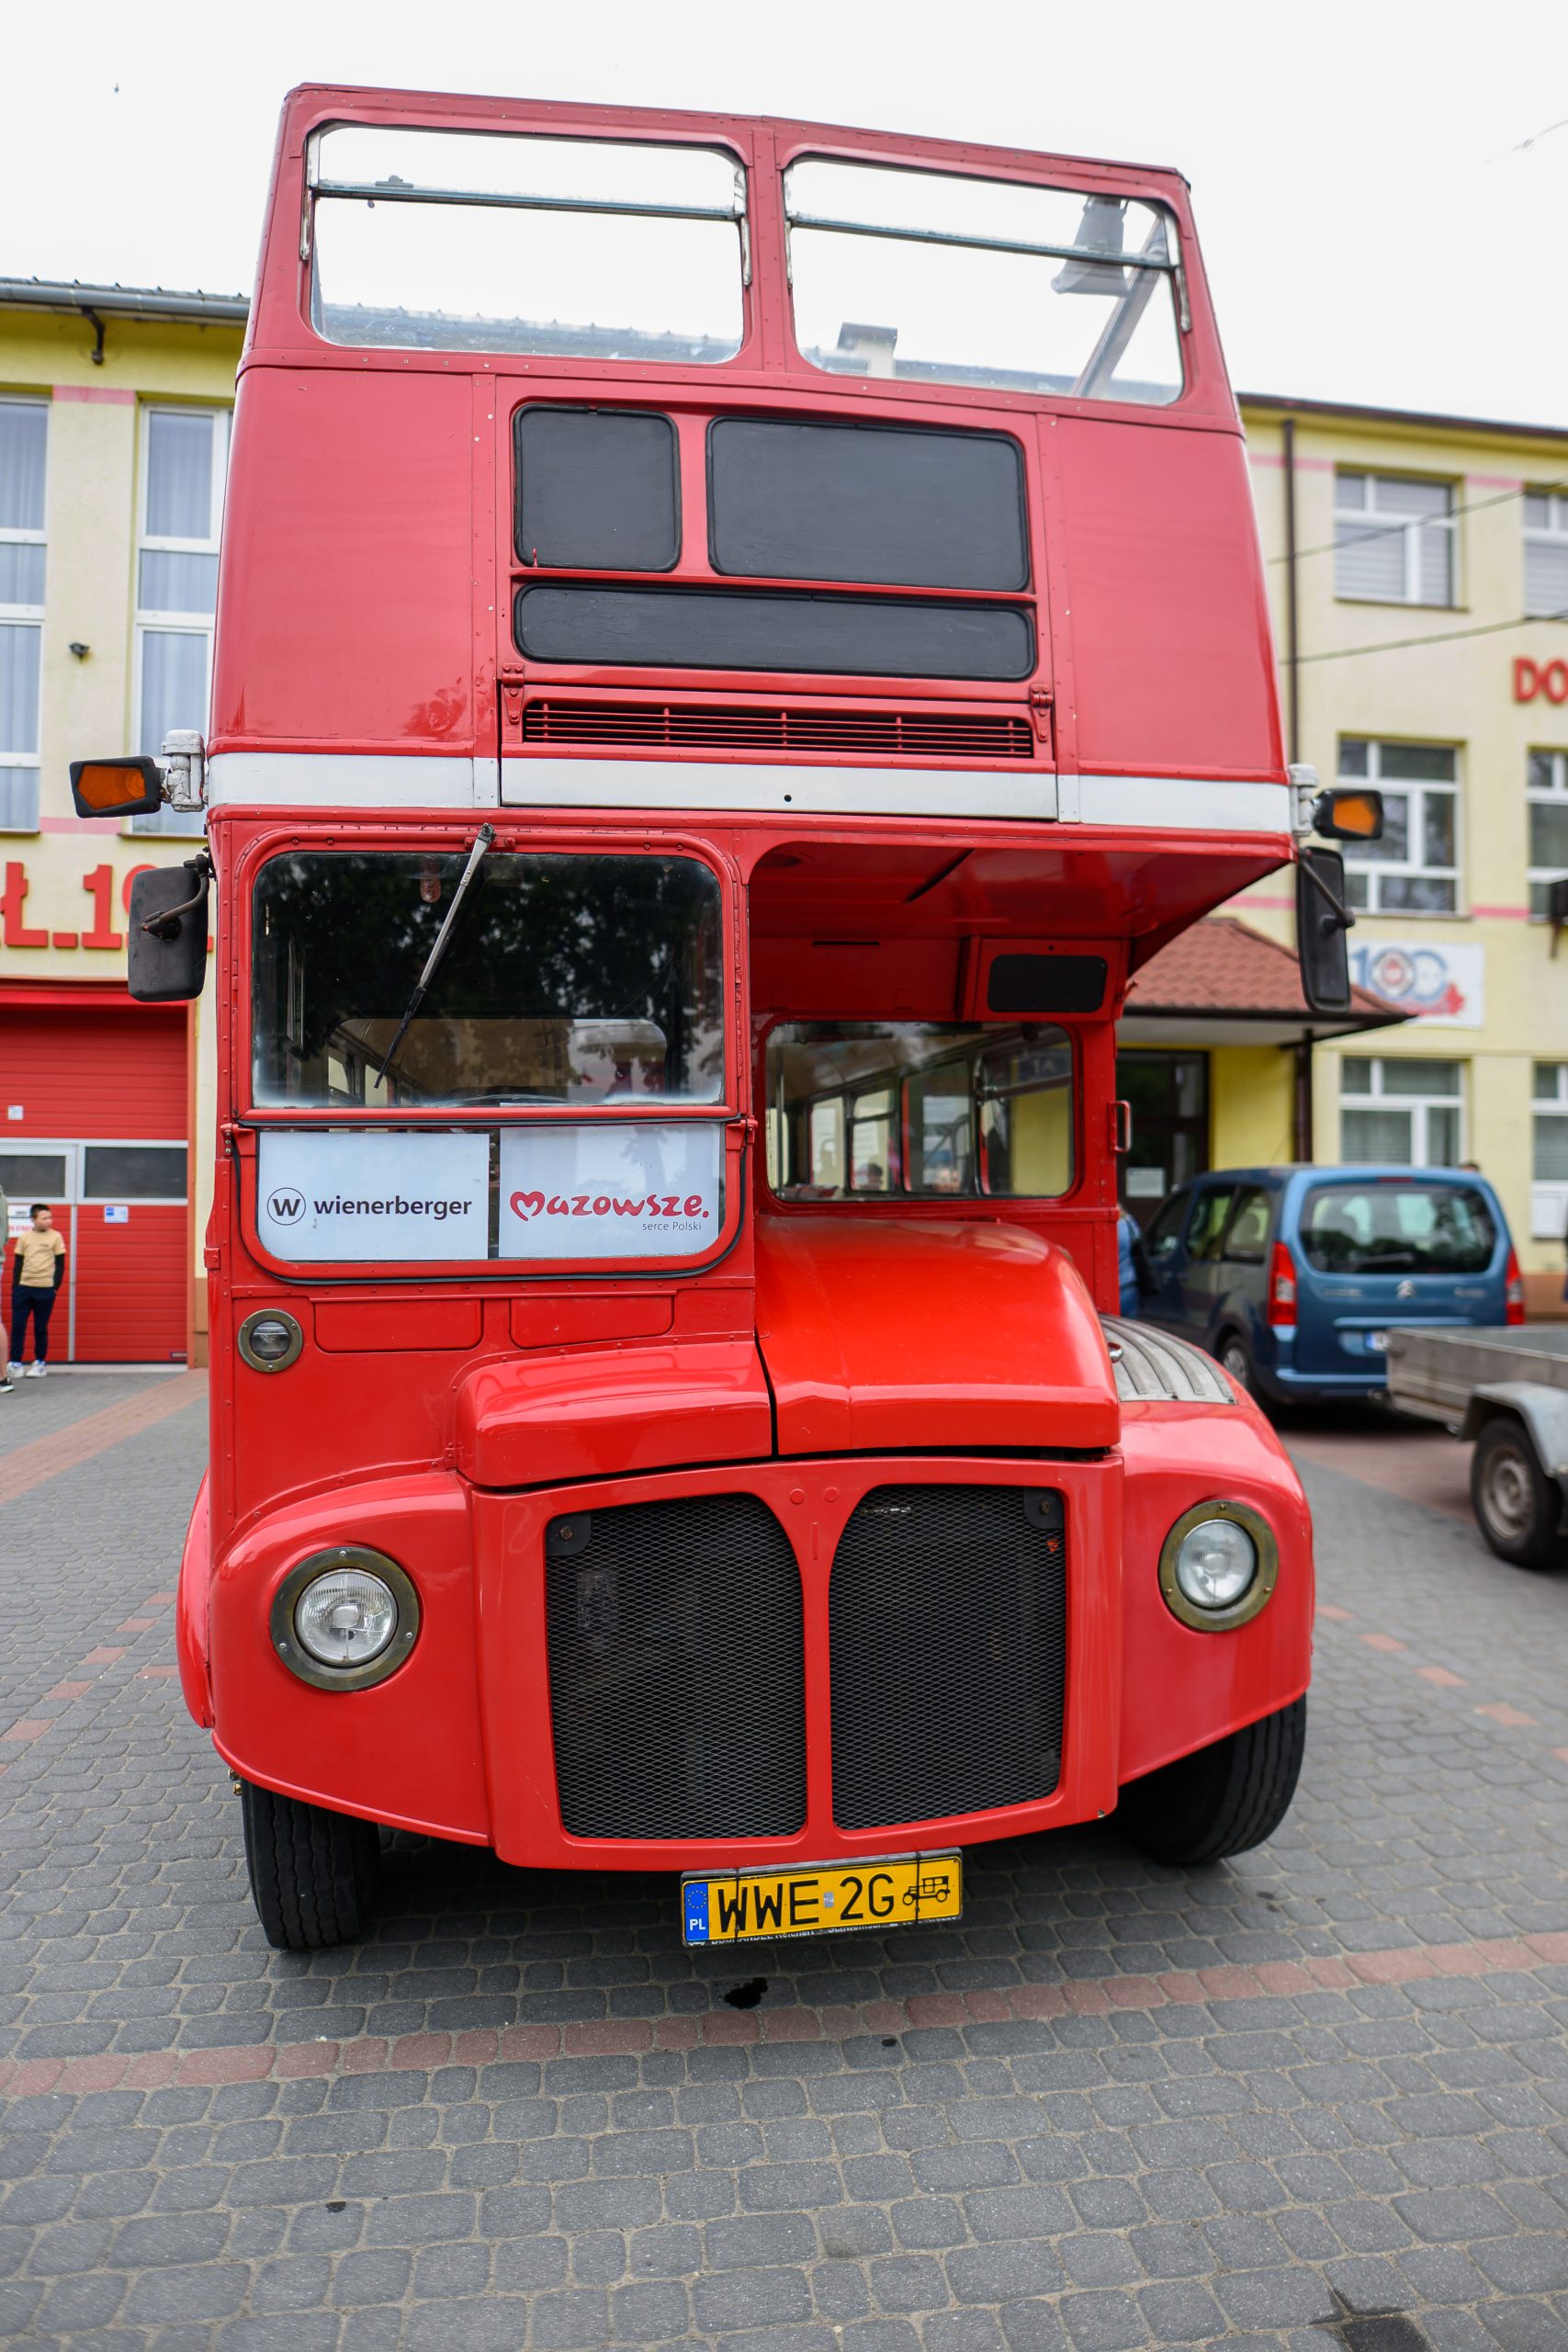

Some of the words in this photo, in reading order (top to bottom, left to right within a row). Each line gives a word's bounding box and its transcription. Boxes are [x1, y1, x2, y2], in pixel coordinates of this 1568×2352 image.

[314, 1195, 472, 1220] wienerberger
[642, 1222, 670, 1231] serce
[672, 1221, 702, 1231] Polski
[717, 1879, 819, 1933] WWE
[840, 1873, 895, 1921] 2G
[690, 1918, 706, 1931] PL
